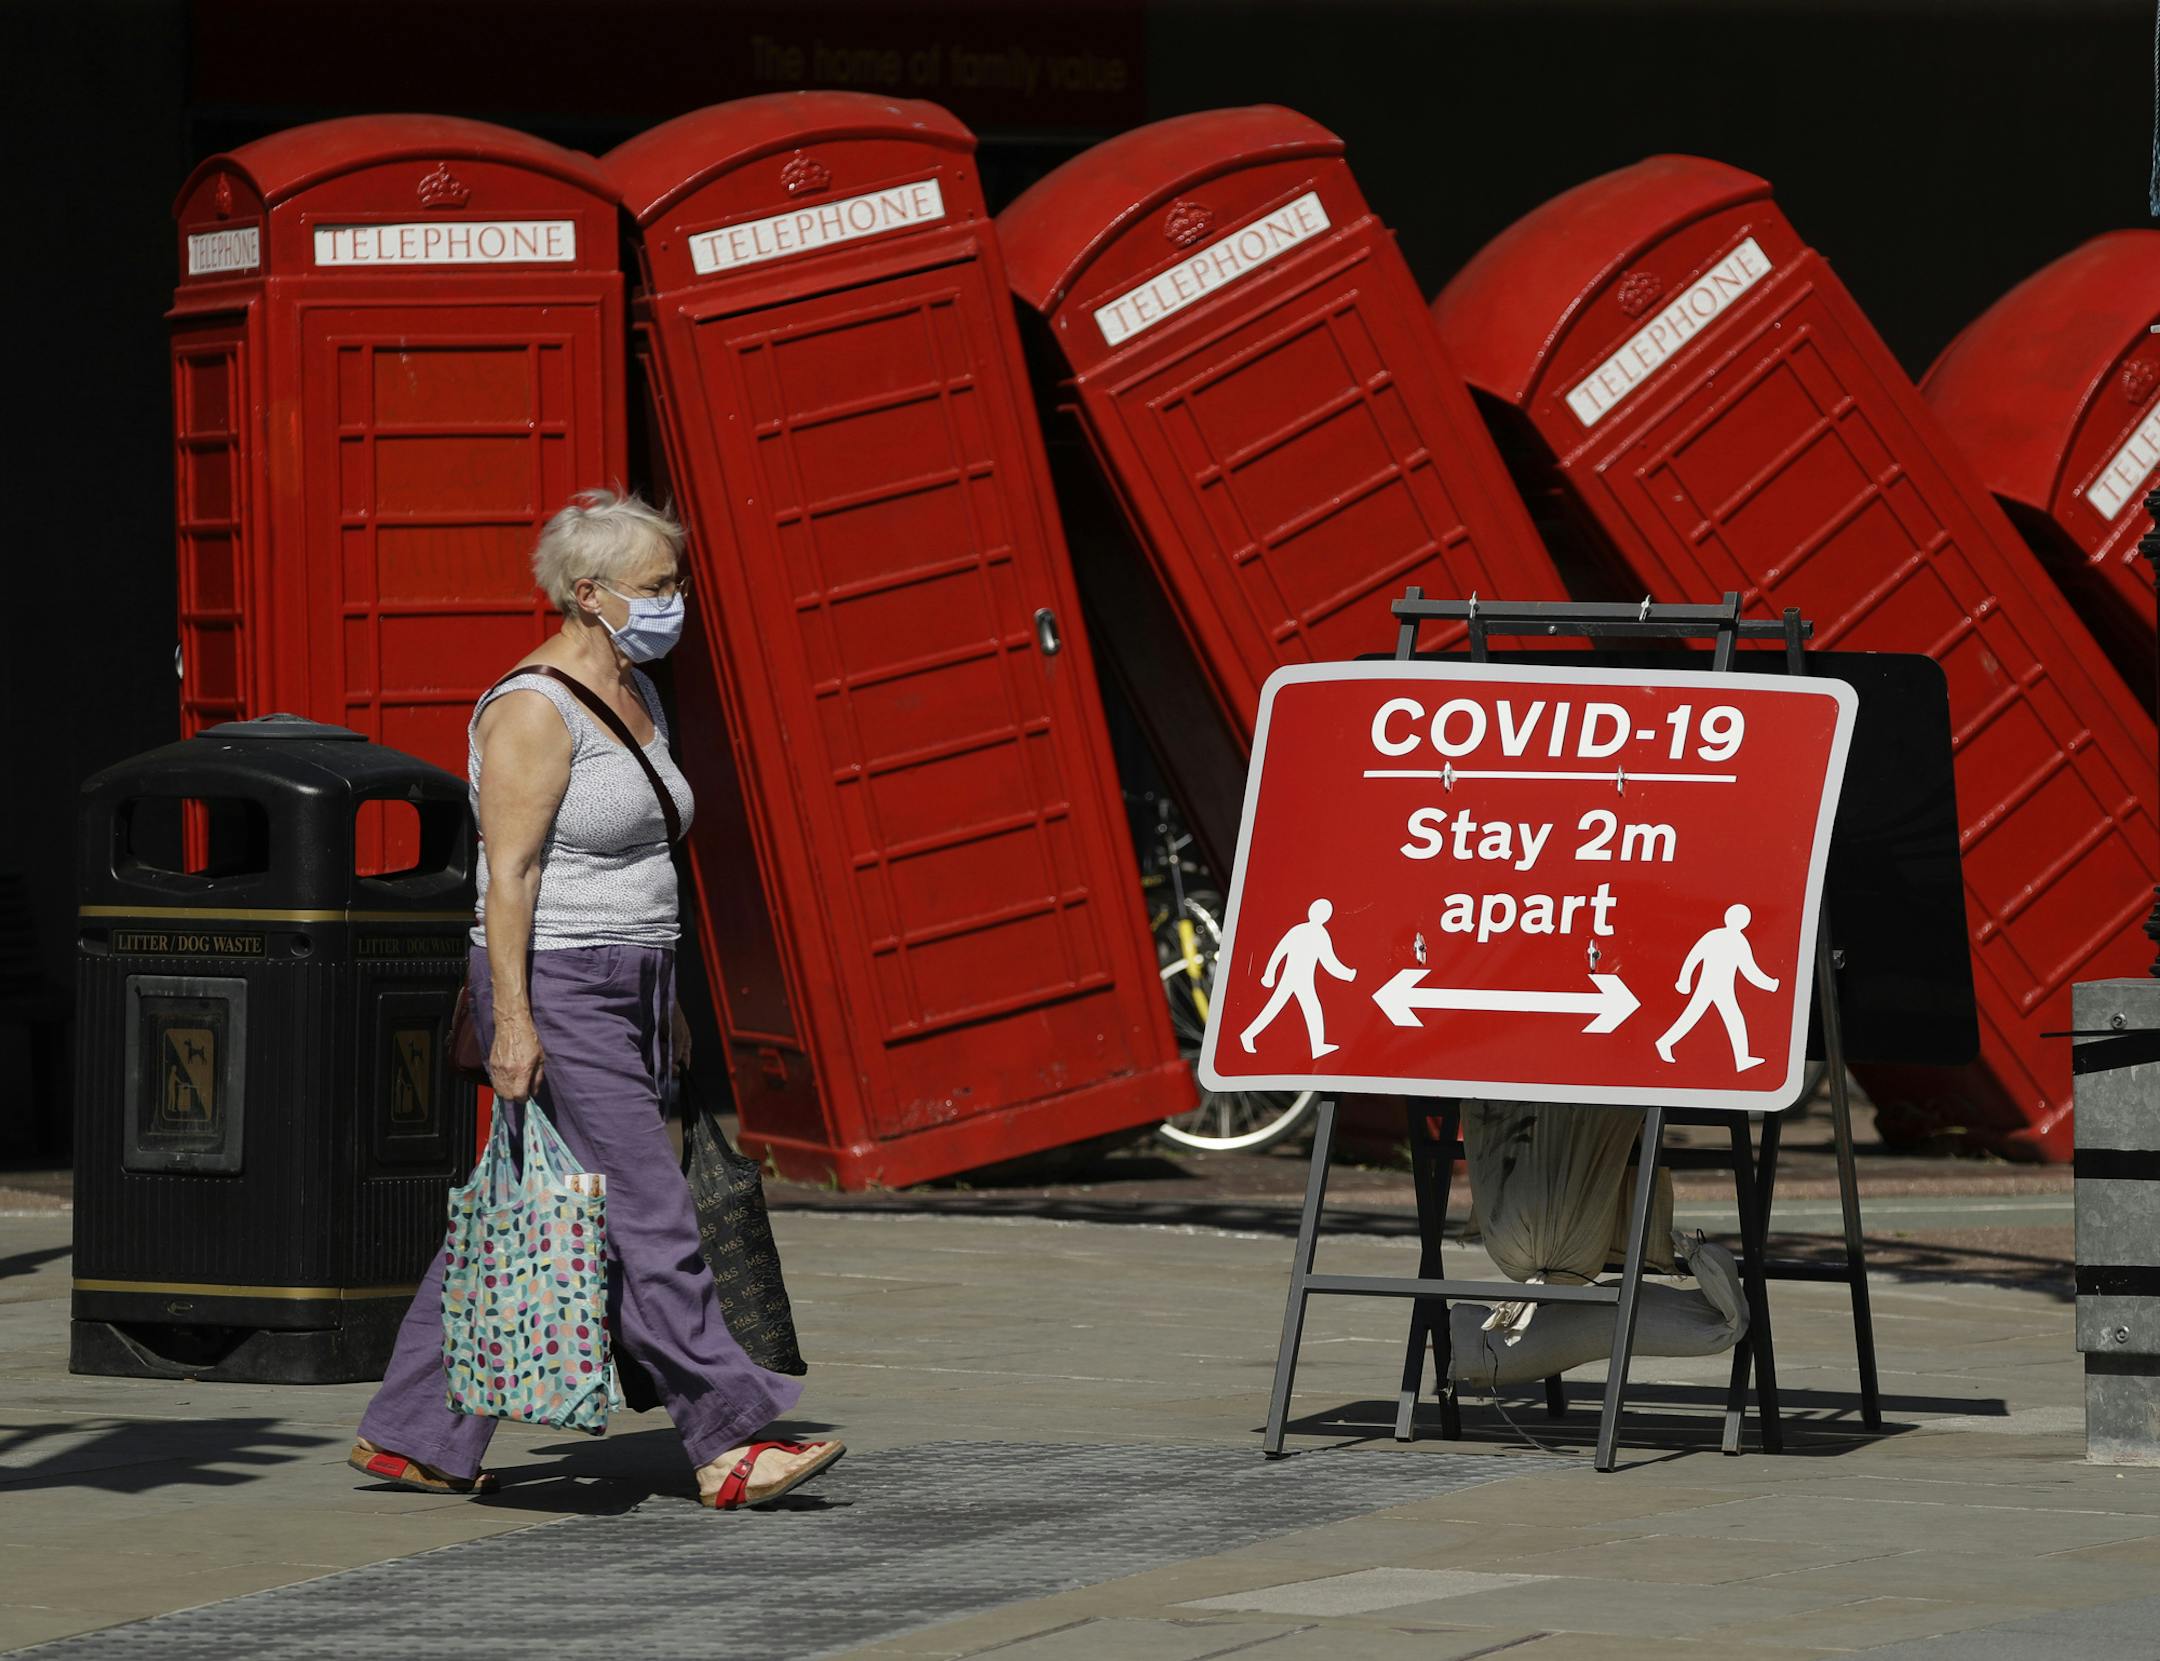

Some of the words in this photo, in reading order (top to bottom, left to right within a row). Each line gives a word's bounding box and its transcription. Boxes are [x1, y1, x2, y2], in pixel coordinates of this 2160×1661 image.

[752, 35, 804, 81] The
[815, 40, 897, 86] home
[909, 44, 940, 86] of
[951, 44, 1038, 97] family
[1048, 48, 1127, 91] value
[192, 231, 257, 270] TELEPHONE
[329, 226, 564, 260] TELEPHONE
[701, 185, 932, 266] TELEPHONE
[1107, 201, 1319, 333] TELEPHONE
[1576, 248, 1762, 410] TELEPHONE
[2096, 414, 2160, 501] TELE
[1372, 698, 1744, 763] COVID-19
[1400, 808, 1553, 870] Stay
[1575, 810, 1676, 861] 2m
[118, 934, 168, 951] LITTER
[178, 935, 210, 952] DOG
[213, 936, 262, 953] WASTE
[1441, 883, 1616, 943] apart
[358, 937, 400, 954] LITTER
[407, 938, 430, 953] DOG
